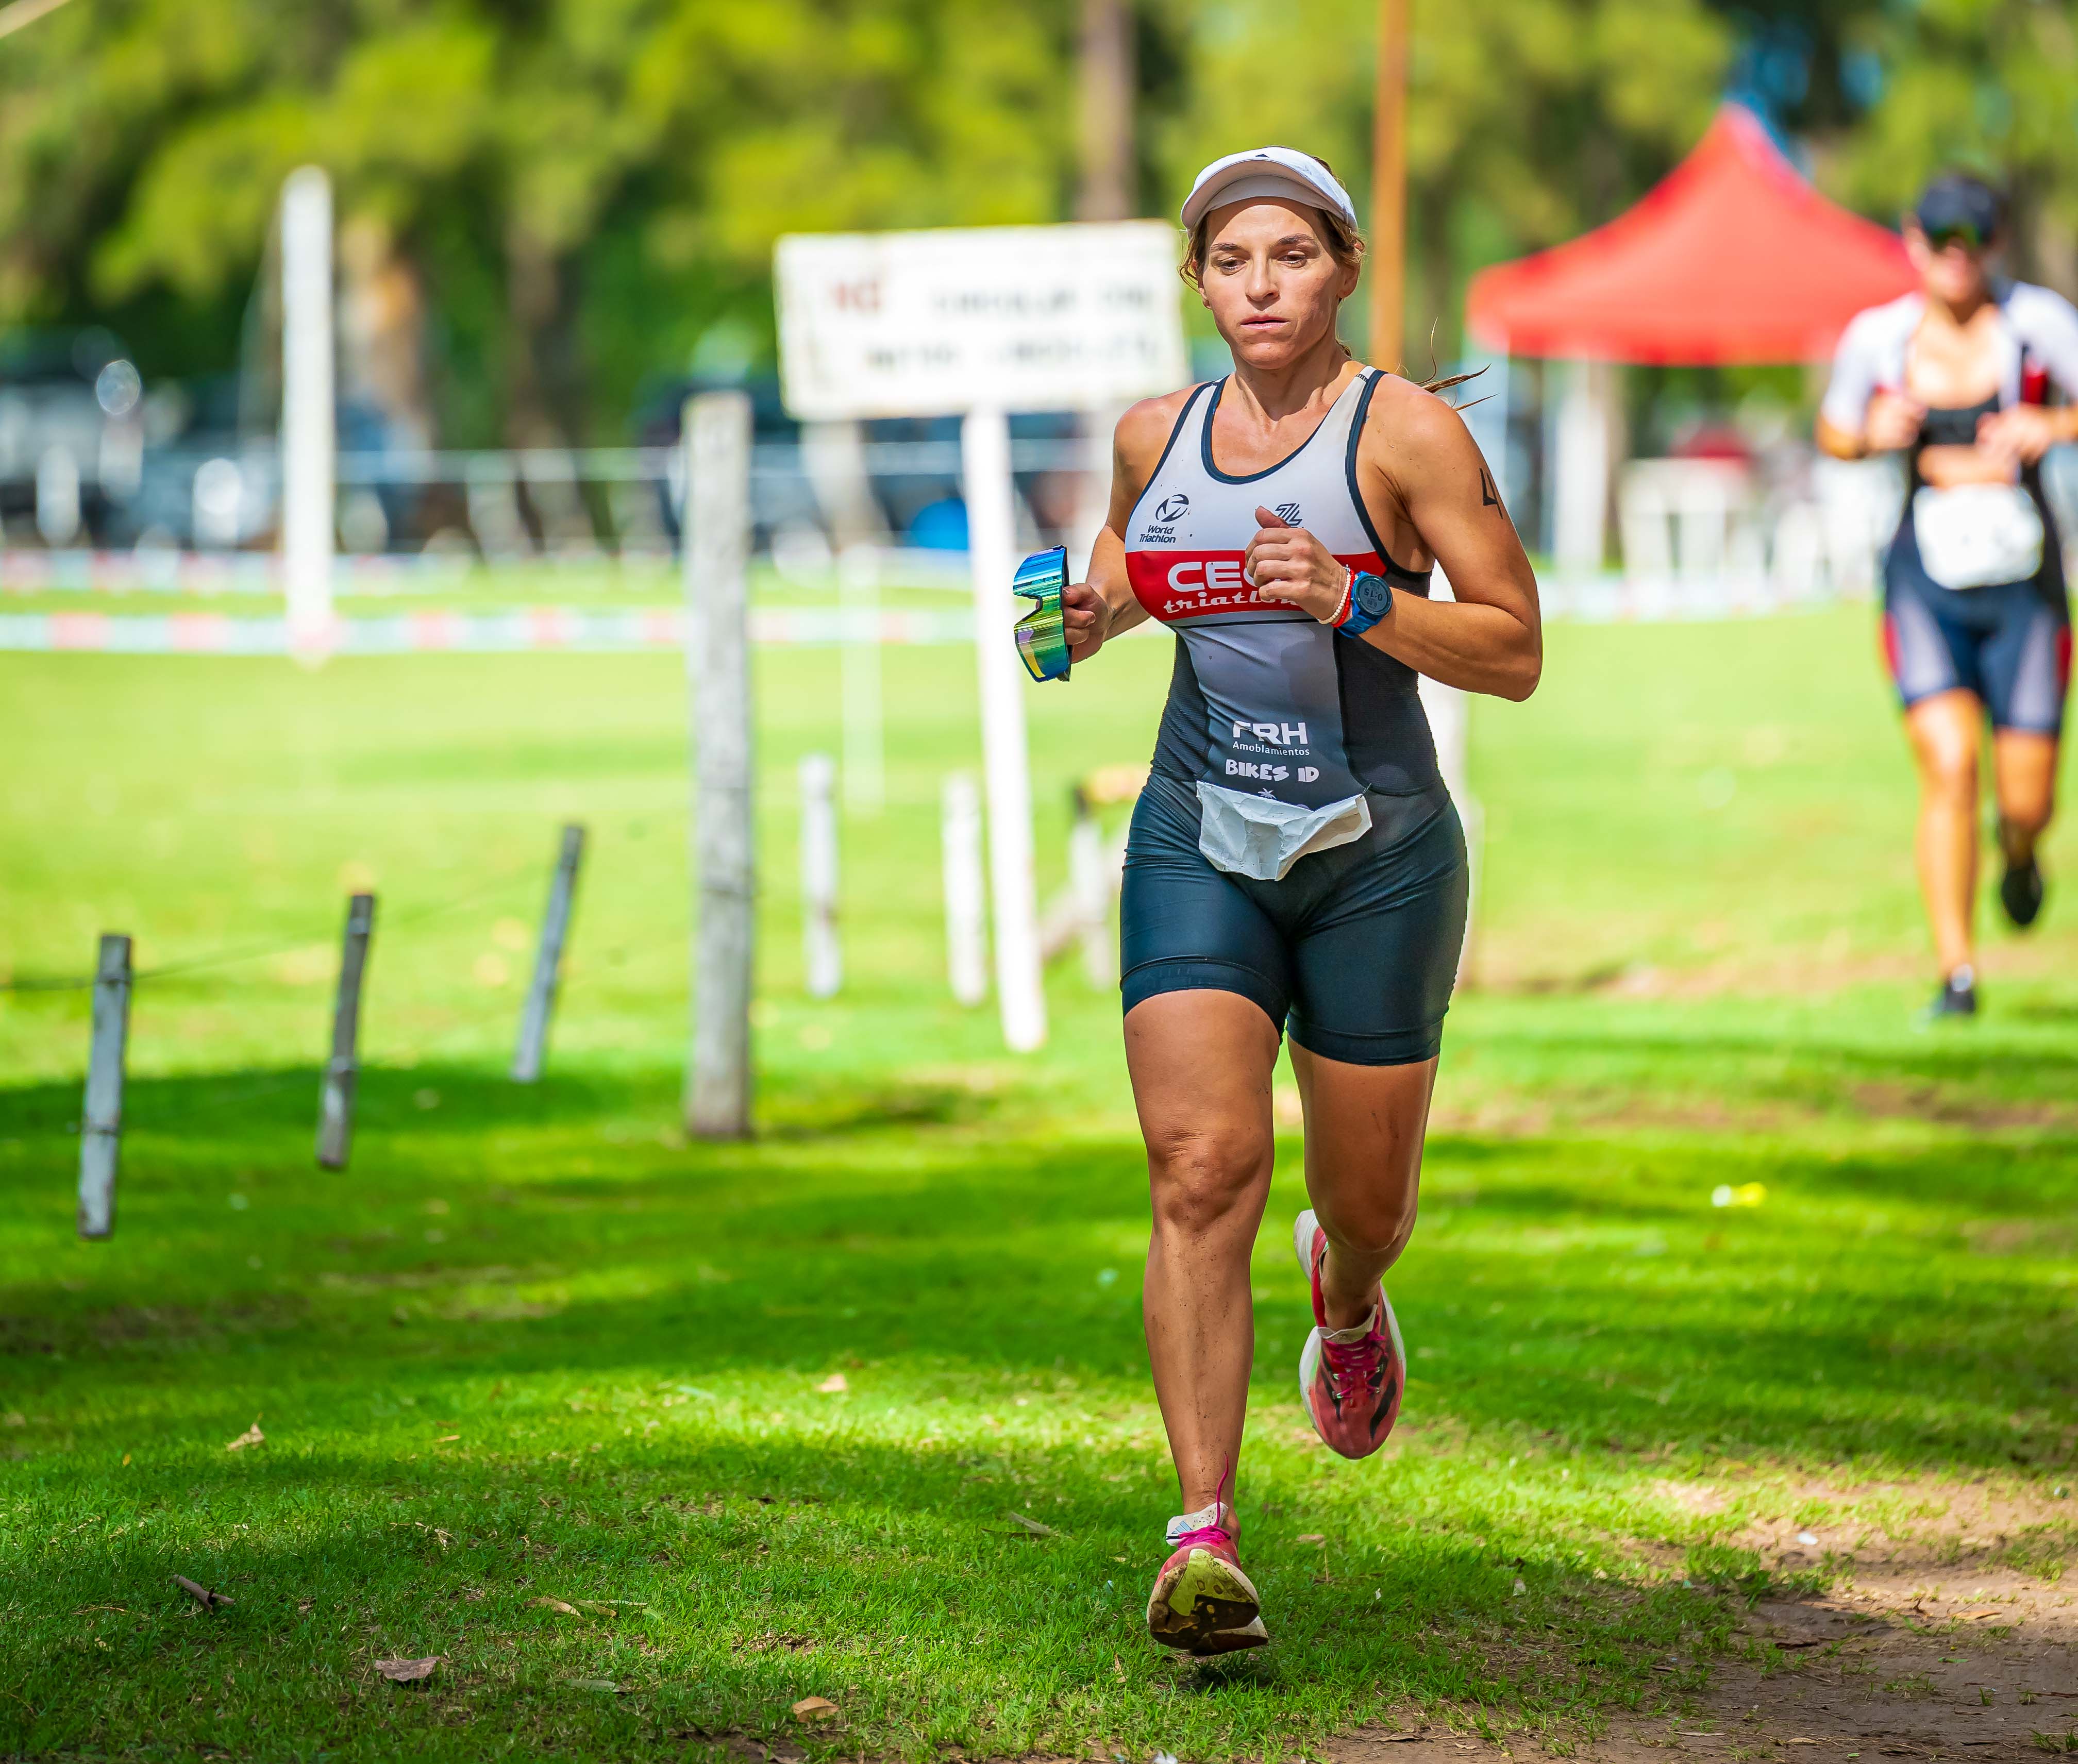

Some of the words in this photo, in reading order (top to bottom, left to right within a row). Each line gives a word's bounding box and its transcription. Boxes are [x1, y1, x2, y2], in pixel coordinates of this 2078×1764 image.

[1479, 468, 1503, 519] 4
[1139, 533, 1176, 543] Triathlon
[1147, 525, 1175, 534] World
[1163, 591, 1299, 613] triatl
[1232, 720, 1308, 745] FRH
[1232, 741, 1310, 756] Amoblamientos
[1225, 759, 1289, 782] BIKES
[1297, 766, 1319, 783] ID
